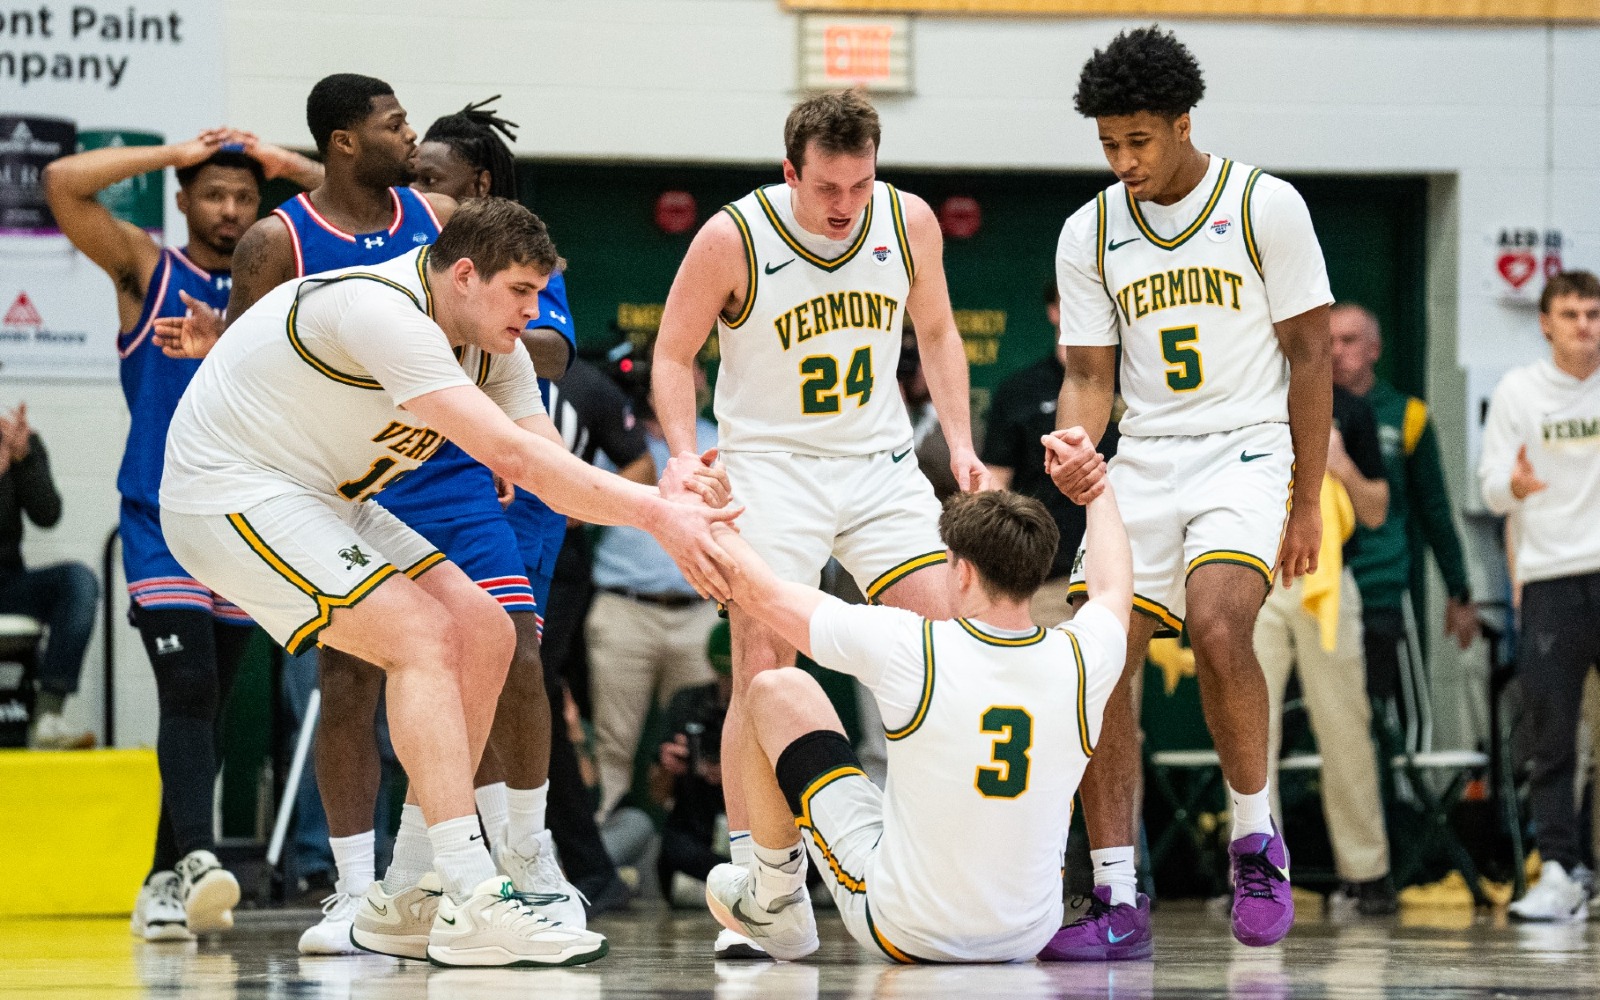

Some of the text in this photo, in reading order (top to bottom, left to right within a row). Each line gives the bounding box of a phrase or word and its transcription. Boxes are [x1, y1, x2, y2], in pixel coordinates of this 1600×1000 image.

[0, 6, 181, 42] nt Paint
[1497, 228, 1539, 248] AED
[773, 290, 899, 352] VERMONT
[1115, 266, 1243, 327] VERMONT
[798, 344, 874, 416] 24
[1158, 324, 1204, 394] 5
[371, 420, 447, 461] VER
[338, 455, 417, 503] 1
[973, 704, 1035, 800] 3
